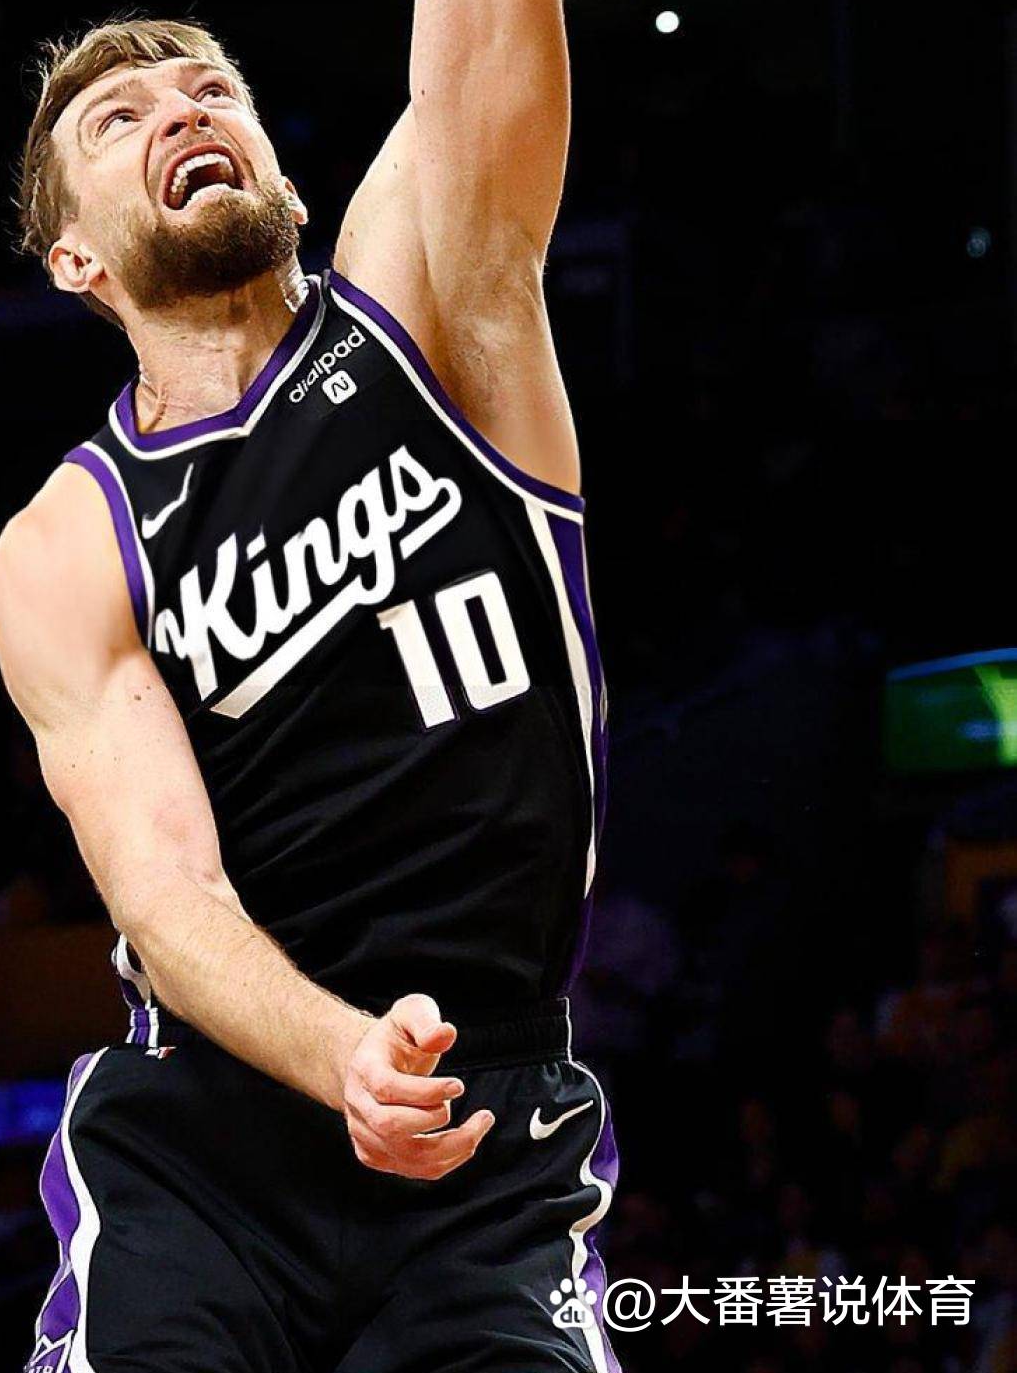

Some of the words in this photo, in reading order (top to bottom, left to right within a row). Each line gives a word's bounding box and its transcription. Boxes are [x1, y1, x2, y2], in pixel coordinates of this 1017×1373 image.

[288, 325, 367, 403] dialpad
[156, 445, 462, 719] Kings
[378, 570, 532, 730] 10
